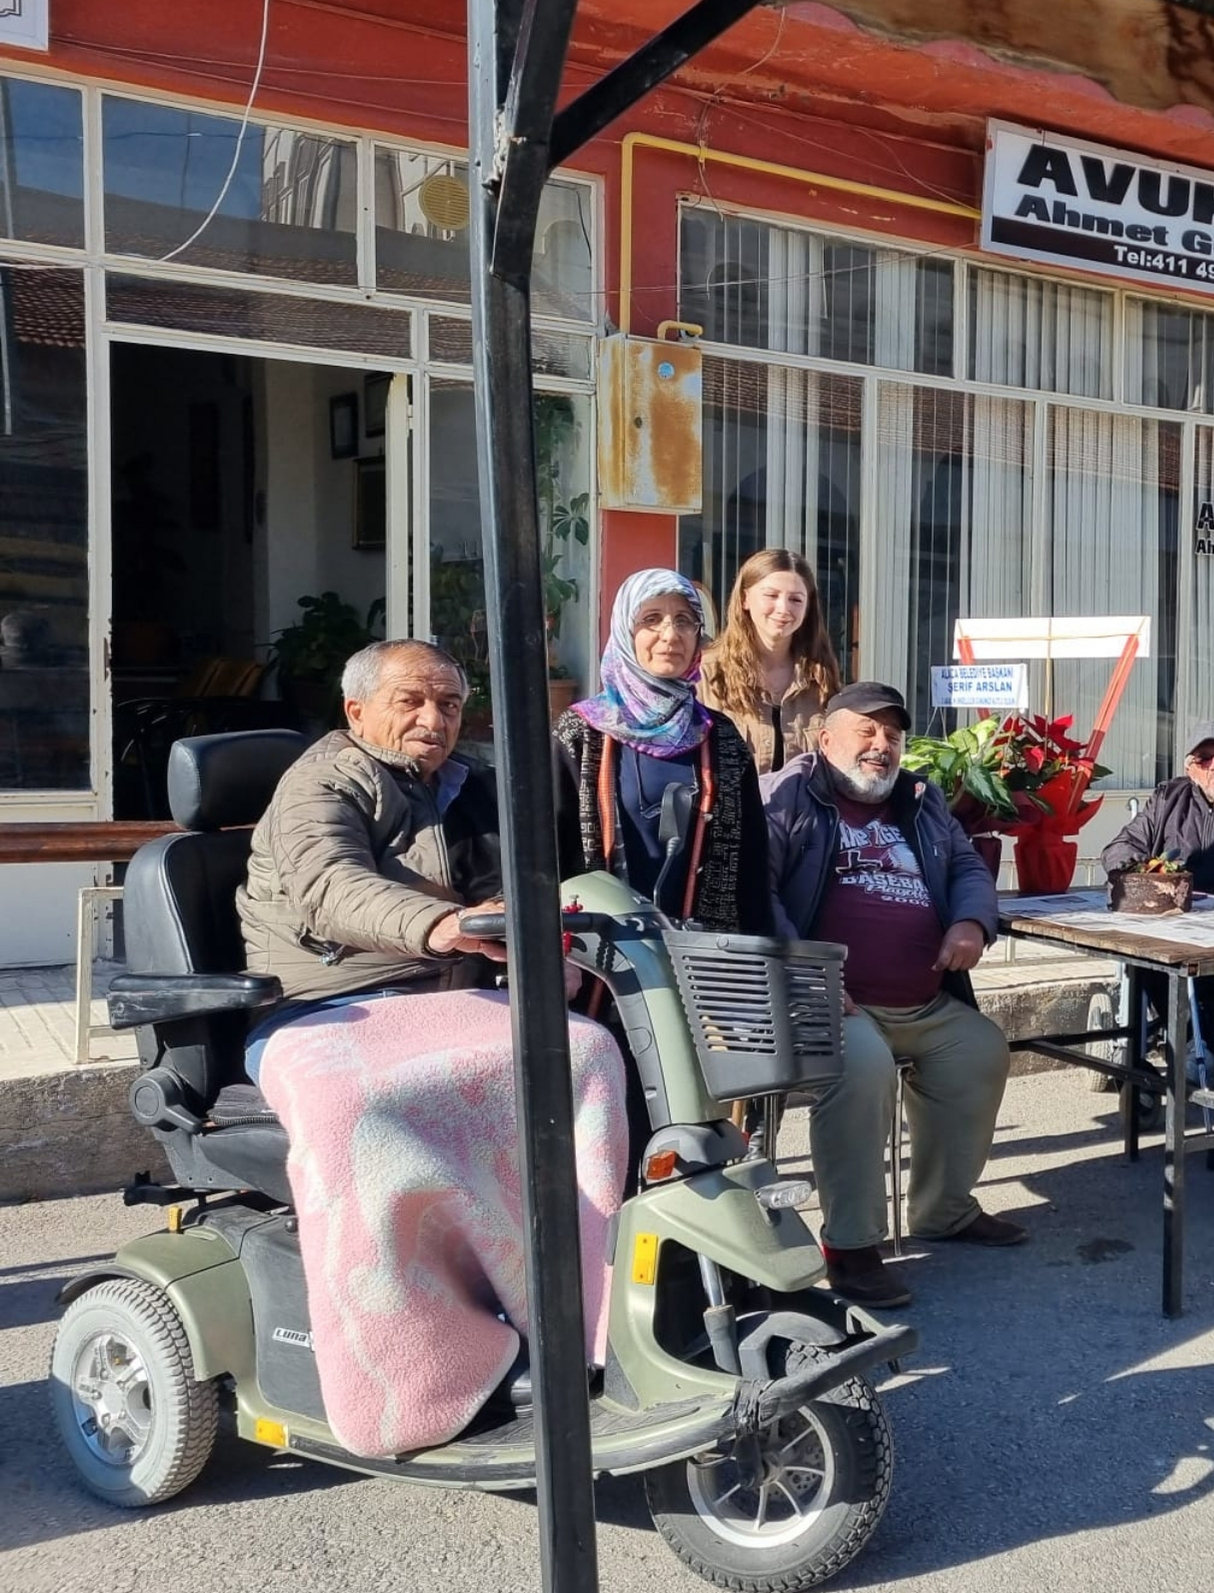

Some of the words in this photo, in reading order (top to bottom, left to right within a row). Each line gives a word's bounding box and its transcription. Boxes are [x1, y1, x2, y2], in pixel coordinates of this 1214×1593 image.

[1014, 194, 1169, 247] Ahmet
[1114, 245, 1188, 275] Tel:411
[976, 681, 1013, 692] ARSLAN
[865, 819, 907, 847] TIGE
